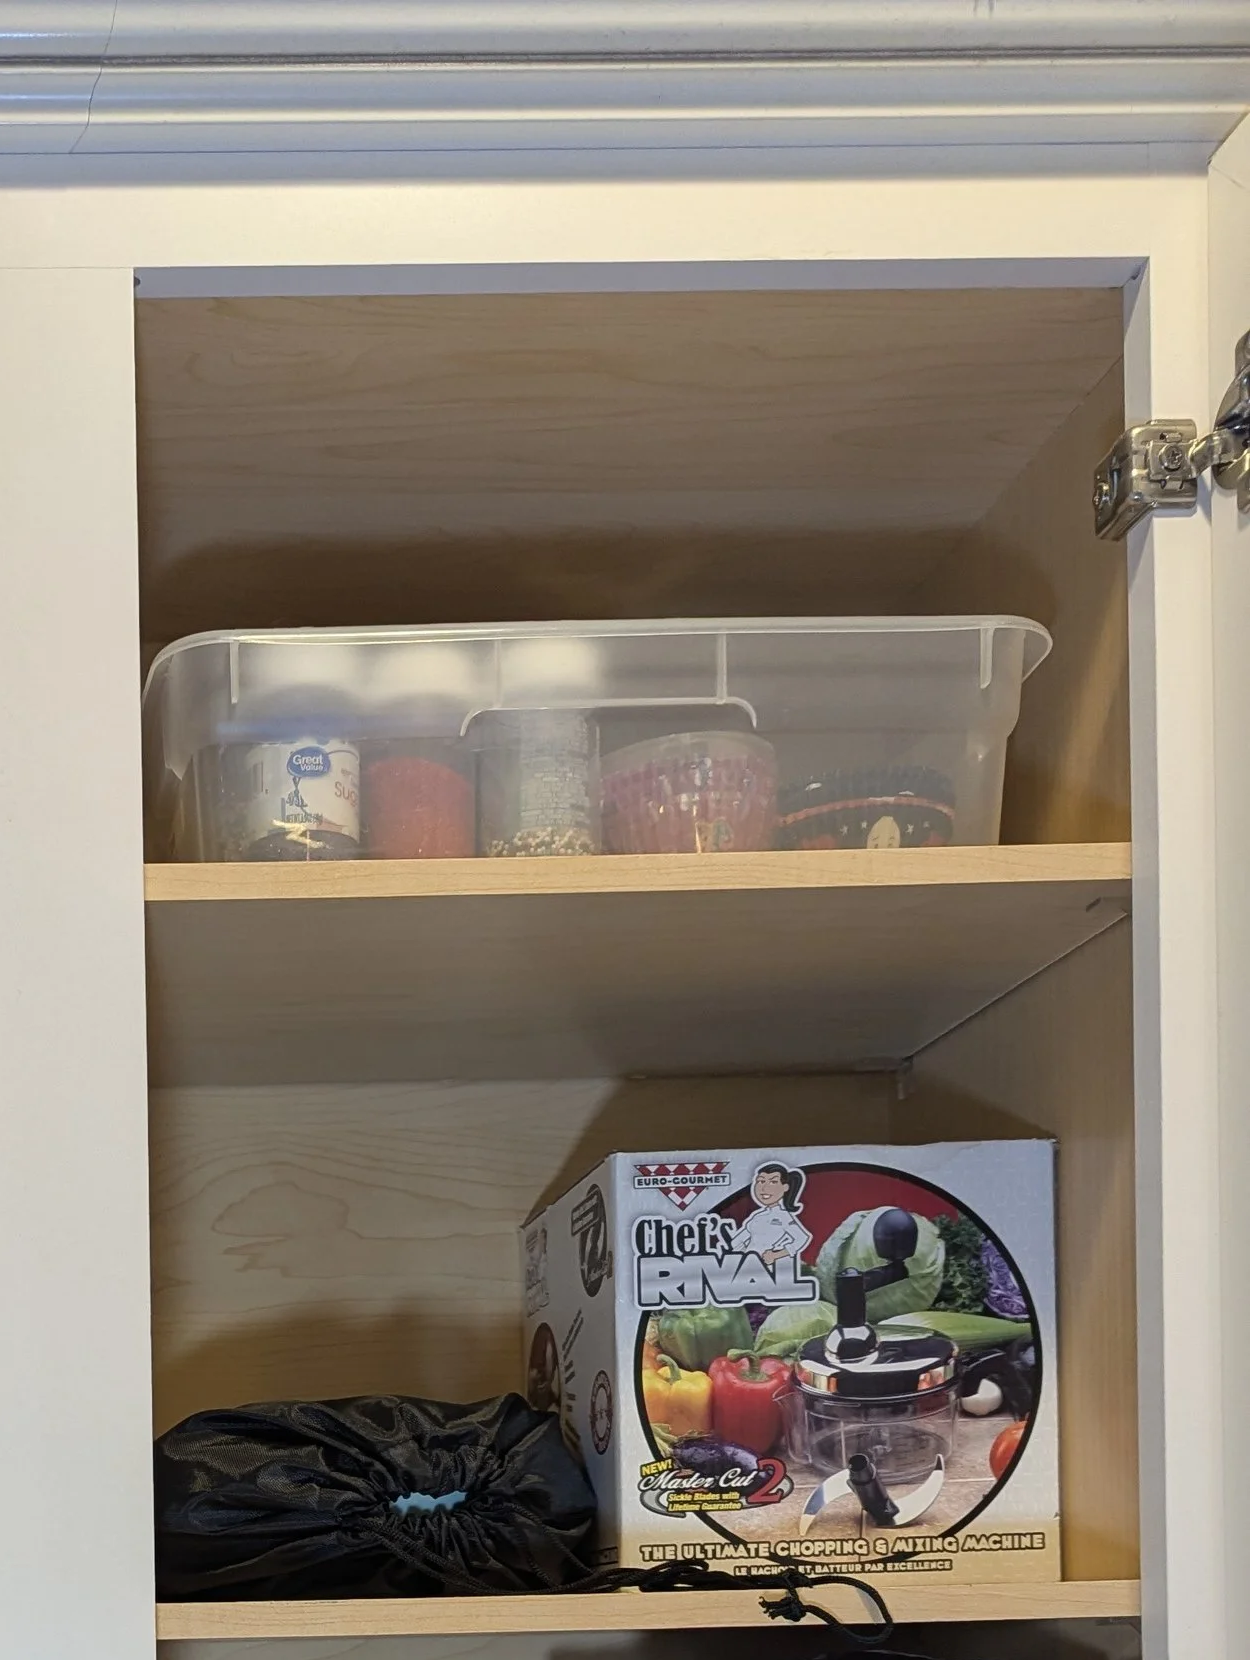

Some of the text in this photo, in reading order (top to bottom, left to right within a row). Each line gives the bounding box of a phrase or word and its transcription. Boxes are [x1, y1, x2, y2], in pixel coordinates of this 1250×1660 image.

[292, 754, 324, 765] Great
[300, 764, 324, 772] Value
[636, 1175, 728, 1187] EURO-GOURMET
[635, 1217, 735, 1256] Chef's
[639, 1252, 816, 1305] RIVAL
[642, 1459, 673, 1475] NEW!
[640, 1458, 786, 1503] Master Cut 2
[668, 1492, 740, 1502] Sickle Blades with
[668, 1502, 742, 1511] Lifetime Guarantee
[640, 1532, 1045, 1561] THE ULTIMATE CHOPPING & MIXING MACHINE
[734, 1566, 748, 1576] LE
[815, 1561, 862, 1574] BATTEUR
[864, 1561, 885, 1573] PAR
[886, 1559, 953, 1572] EXCELLENCE
